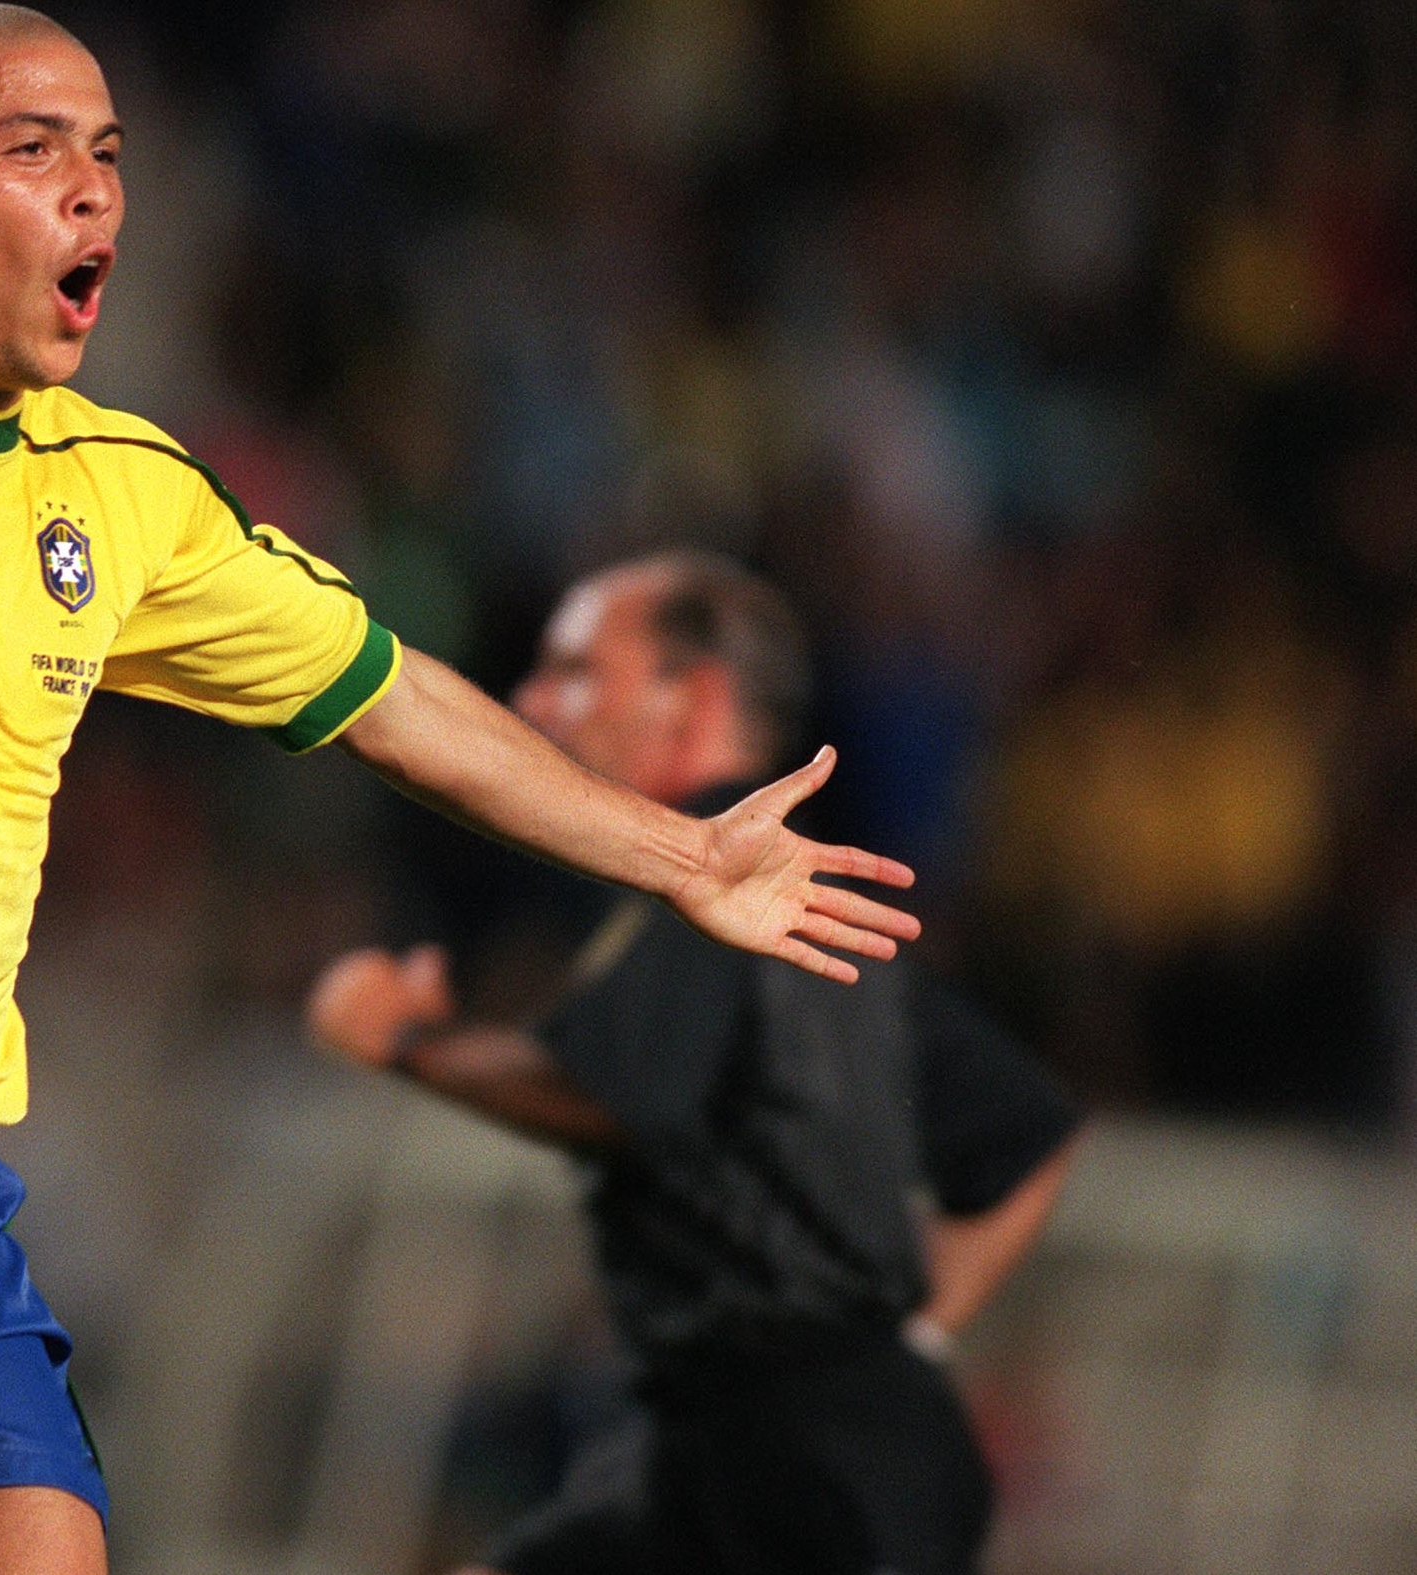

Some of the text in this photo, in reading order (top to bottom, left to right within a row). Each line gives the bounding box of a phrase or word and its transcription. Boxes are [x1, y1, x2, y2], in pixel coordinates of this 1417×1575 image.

[57, 556, 74, 567] CBF
[31, 653, 53, 671] FIFA
[55, 656, 85, 676] WORLD
[42, 675, 76, 696] FRANCE
